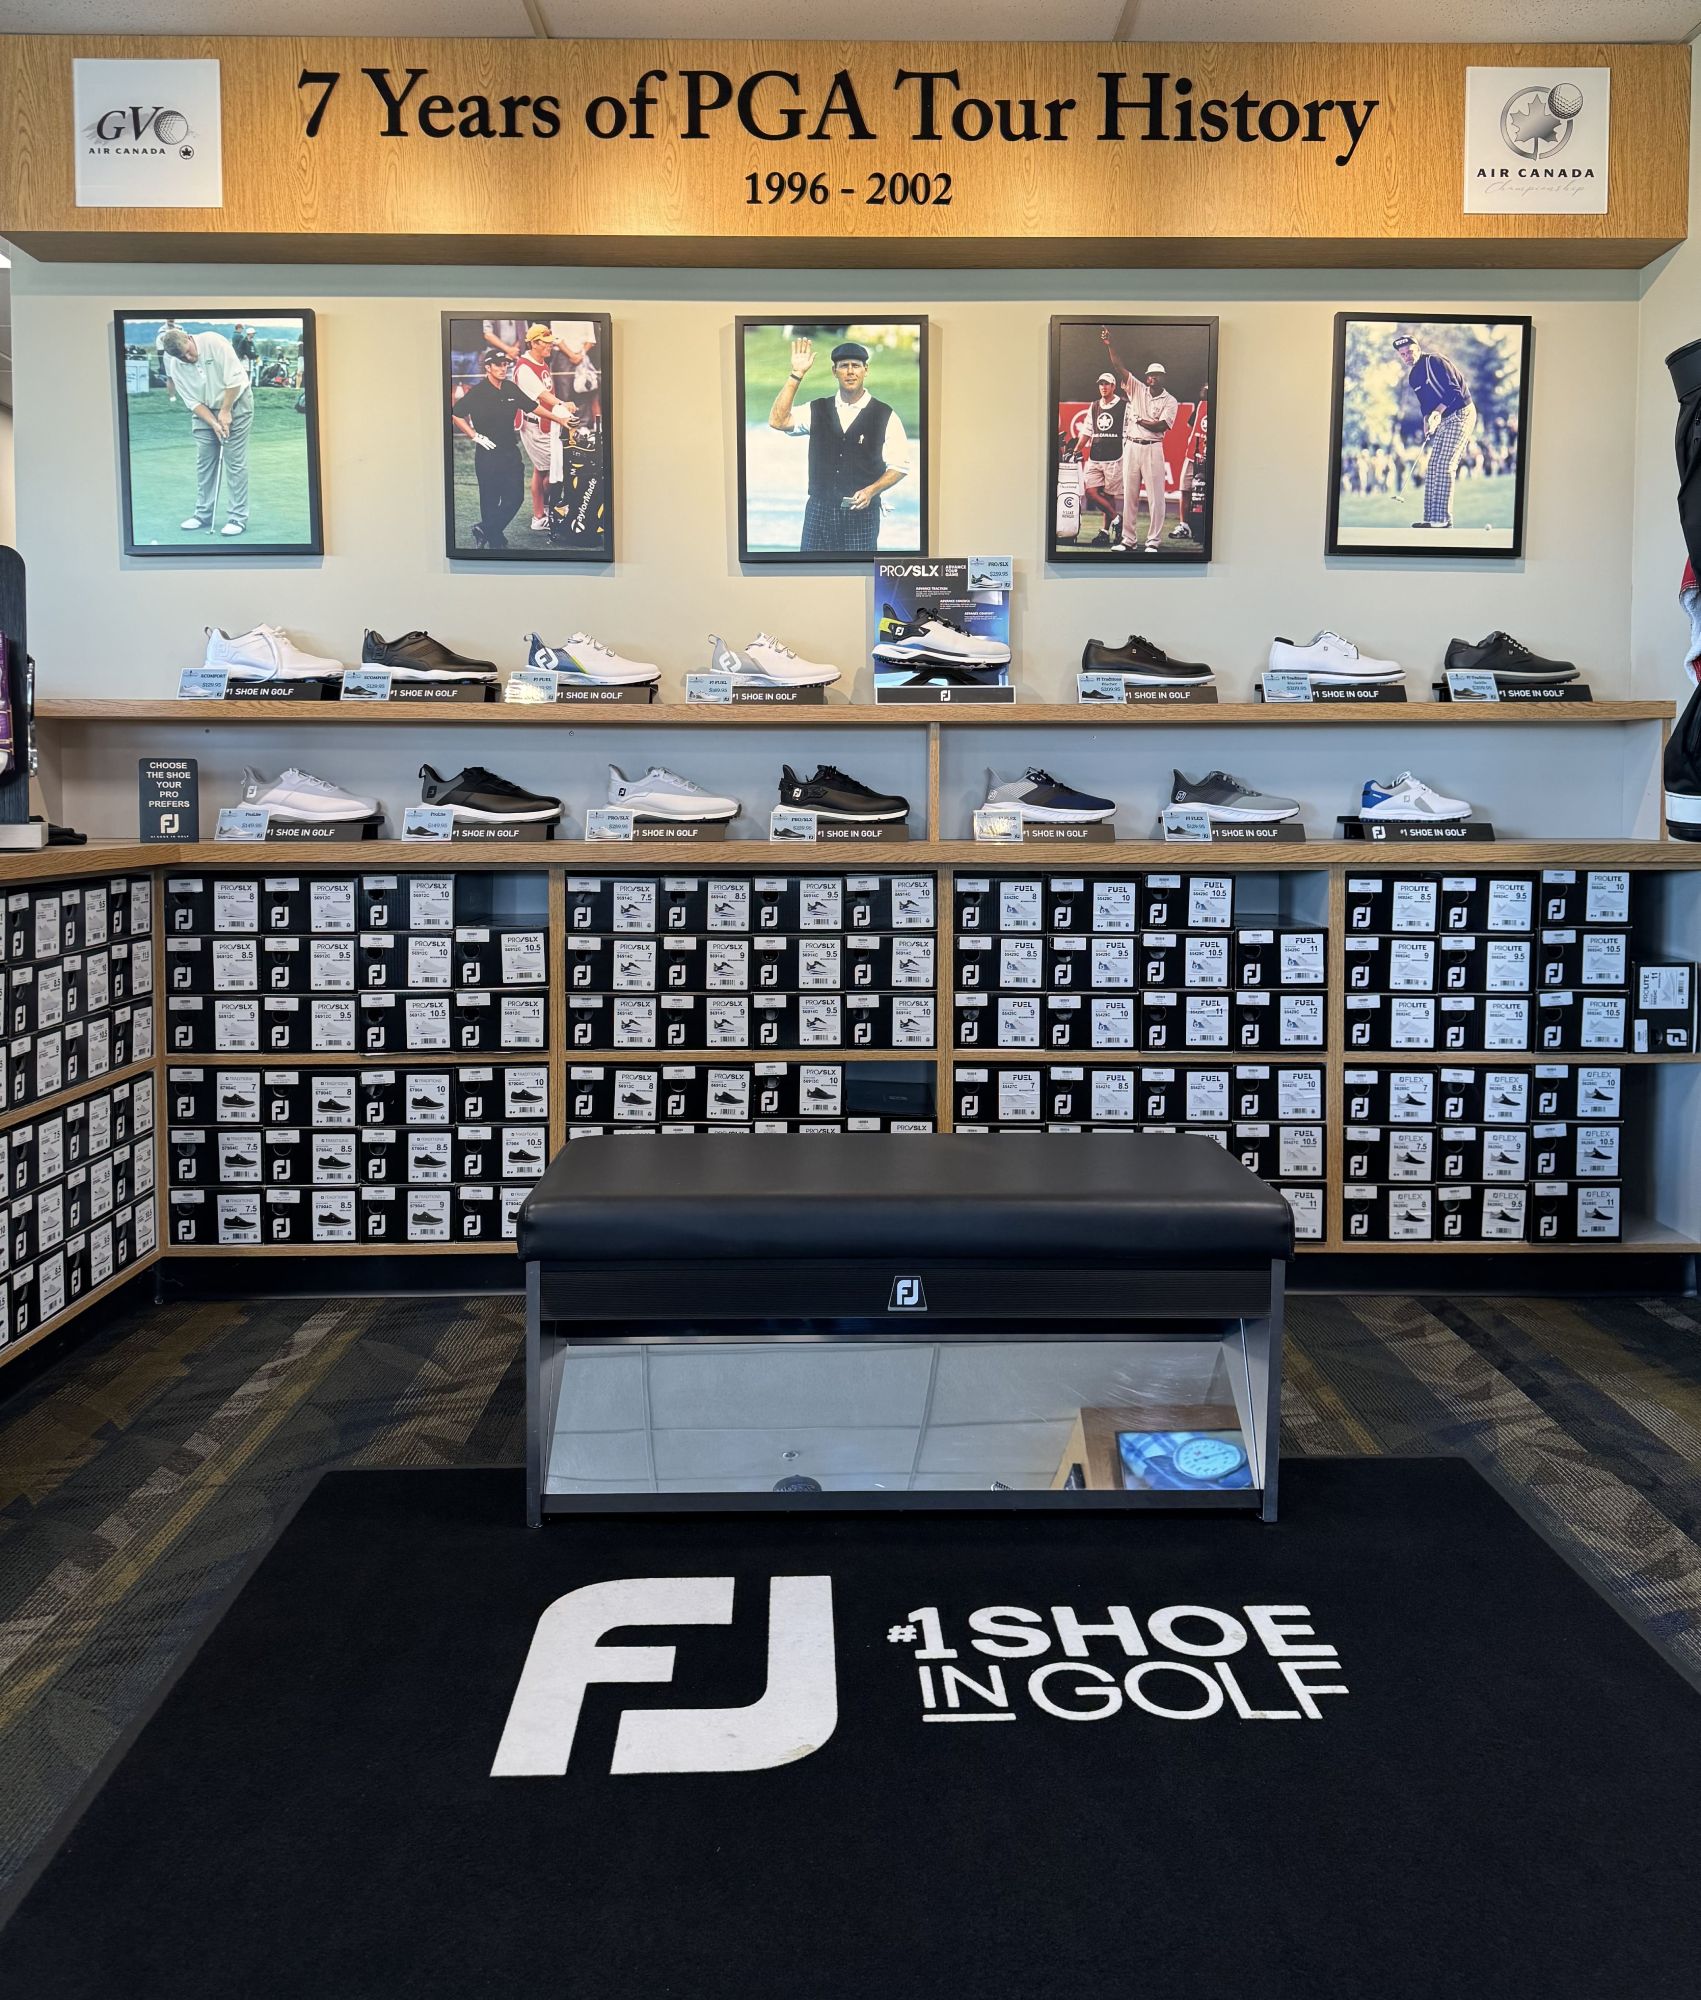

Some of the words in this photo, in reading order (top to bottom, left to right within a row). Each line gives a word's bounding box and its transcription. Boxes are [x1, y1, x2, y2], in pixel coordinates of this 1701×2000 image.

[297, 70, 341, 139] 7
[361, 68, 561, 140] Years
[585, 69, 667, 141] of
[680, 71, 878, 141] PGA
[894, 68, 1076, 141] Tour
[1096, 72, 1380, 166] History
[89, 147, 110, 155] AIR
[115, 147, 166, 155] CANADA
[1477, 168, 1510, 178] AIR
[1518, 168, 1595, 178] CANADA
[745, 172, 829, 205] 1996
[865, 173, 953, 205] 2002
[879, 564, 939, 577] PRO/SLX
[895, 627, 904, 635] FJ
[940, 689, 950, 701] FJ
[161, 814, 180, 834] FJ
[1372, 826, 1386, 839] FJ
[897, 1280, 918, 1305] FJ
[886, 1607, 958, 1660] #1
[970, 1604, 1340, 1658] SHOE
[489, 1575, 838, 1777] FJ
[918, 1664, 1014, 1722] IN
[1028, 1660, 1349, 1721] GOLF
